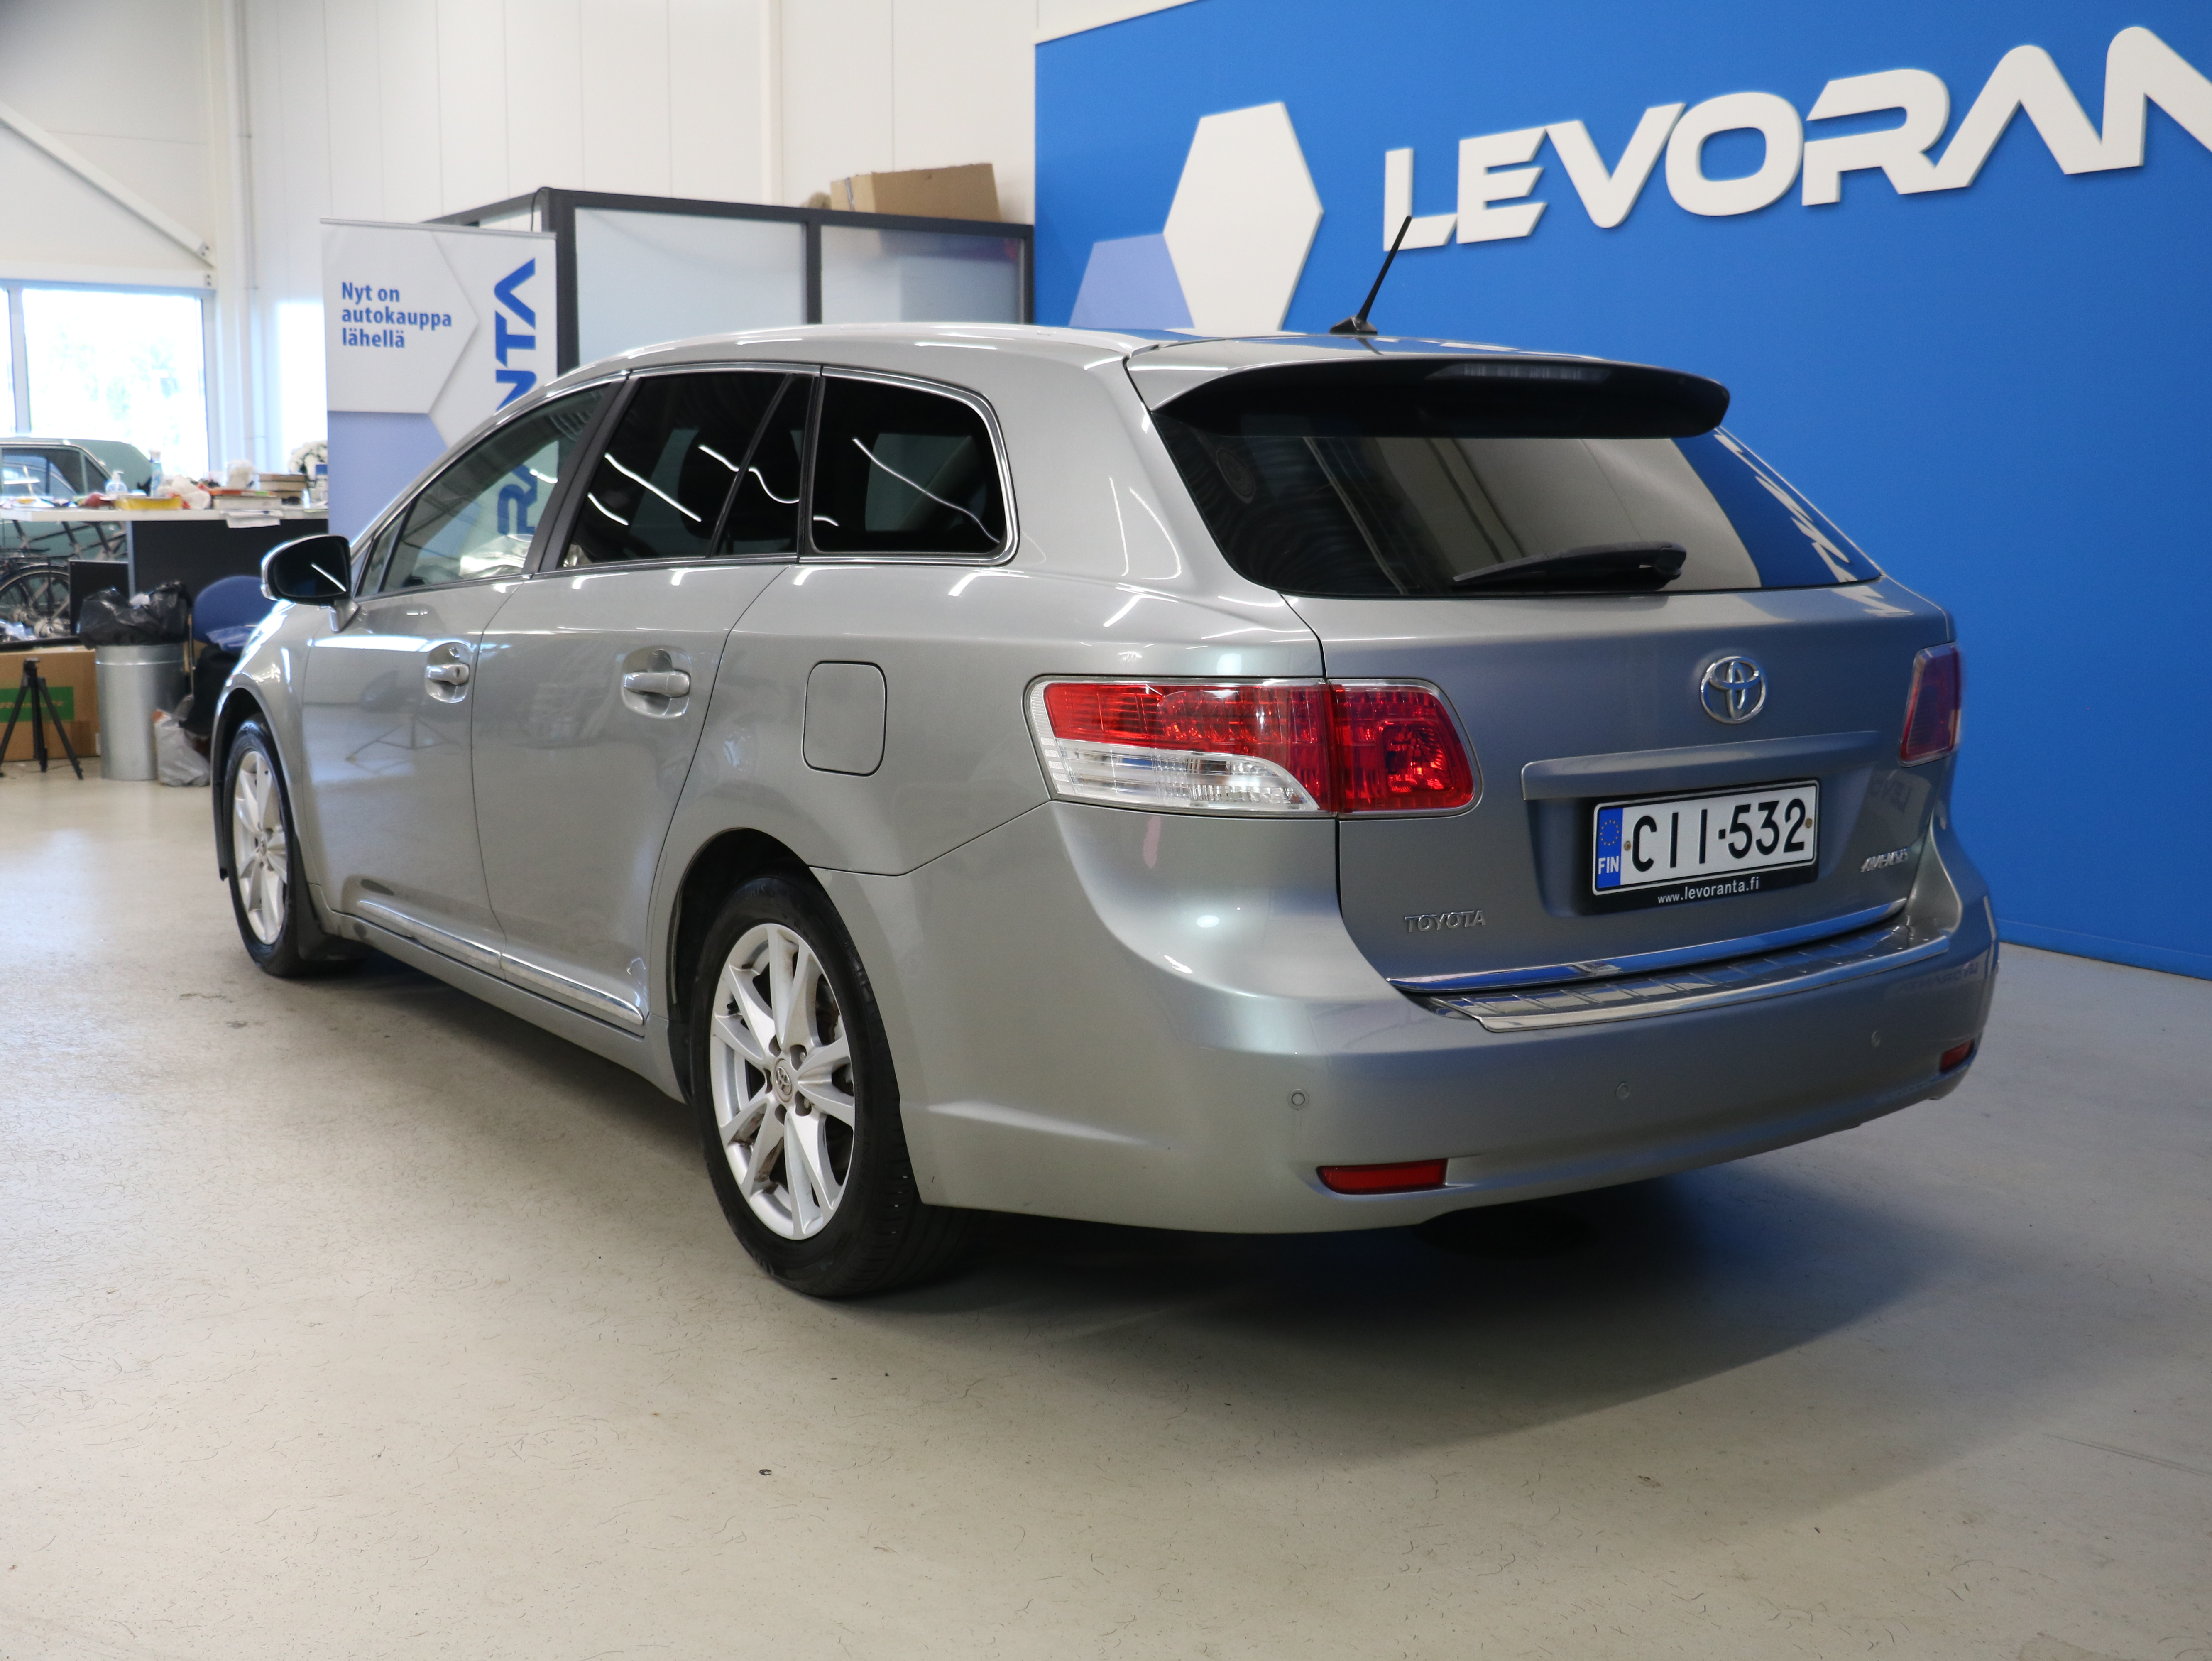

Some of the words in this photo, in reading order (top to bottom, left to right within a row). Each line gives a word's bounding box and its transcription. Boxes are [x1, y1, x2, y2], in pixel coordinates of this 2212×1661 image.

[1383, 26, 2212, 251] LEVORAN
[342, 282, 372, 305] Nyt
[377, 288, 400, 303] on
[342, 306, 452, 331] autokauppa
[342, 328, 405, 348] lähellä
[1632, 798, 1806, 872] CII-532
[1598, 855, 1620, 875] FIN
[1658, 877, 1759, 904] www.levoranta.fi
[1404, 909, 1486, 933] TOYOTA
